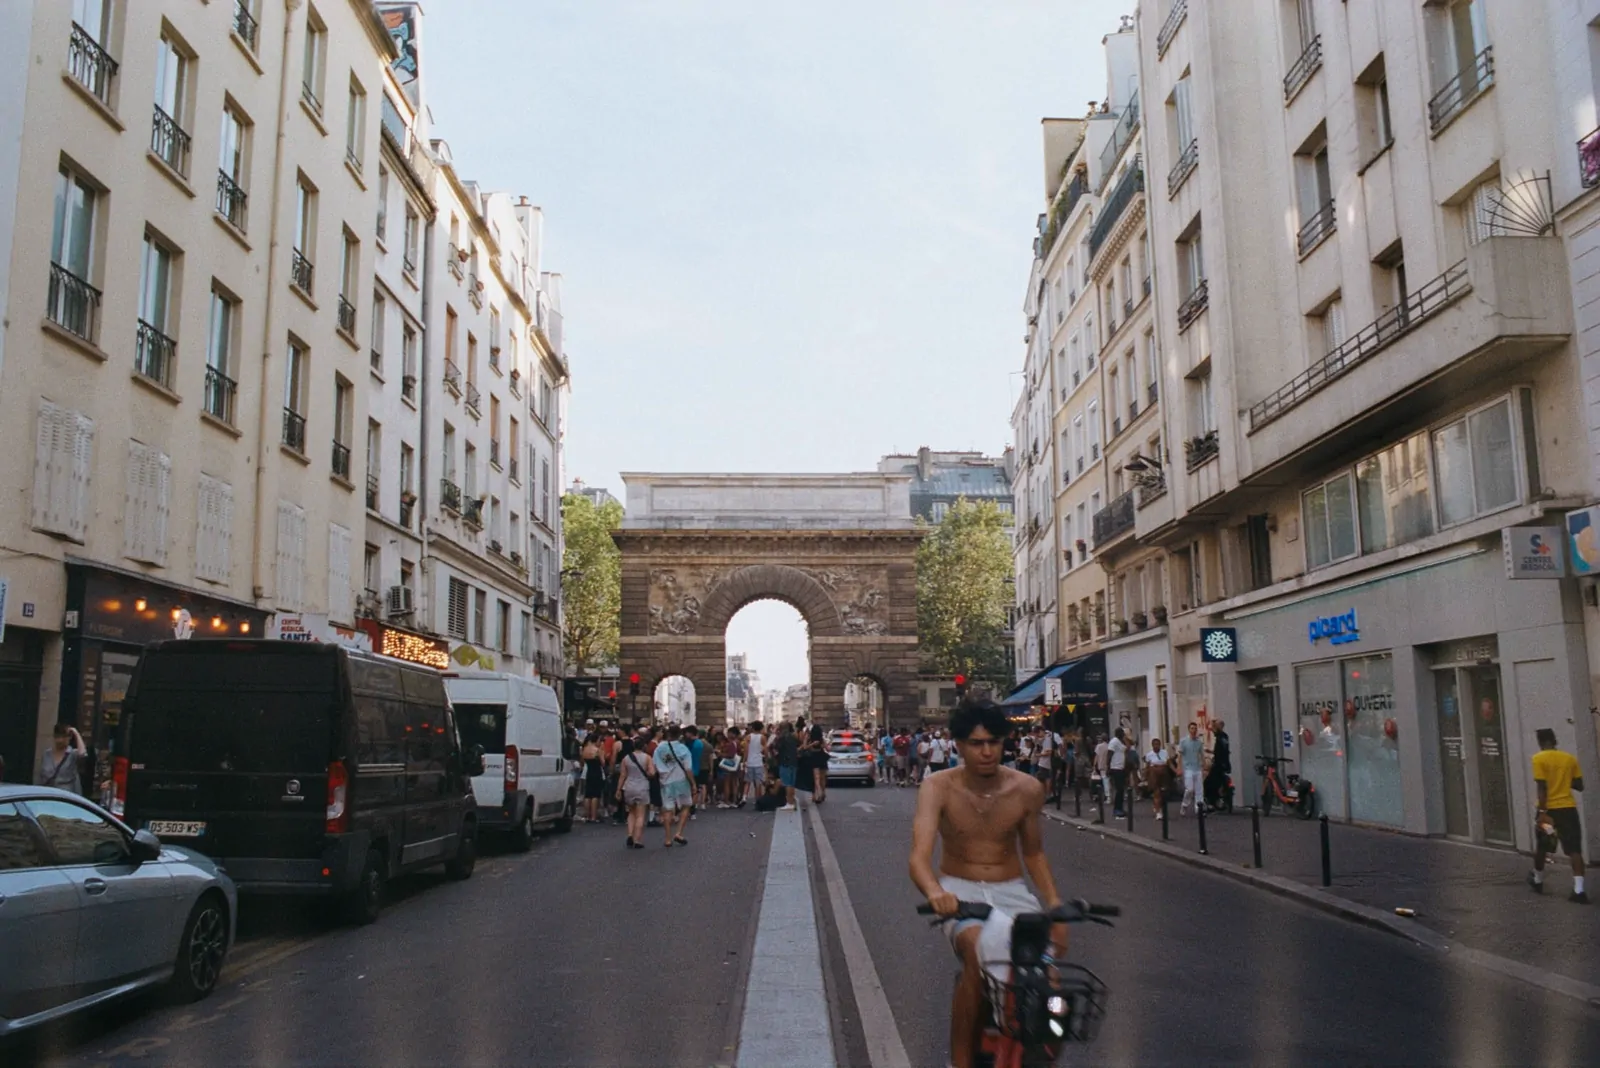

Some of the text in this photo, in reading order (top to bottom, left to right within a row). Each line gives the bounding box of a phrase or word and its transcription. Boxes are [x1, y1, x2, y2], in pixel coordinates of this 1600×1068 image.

[1308, 607, 1356, 645] picard
[280, 630, 312, 641] SANTÉ
[1353, 694, 1393, 711] OUVERT
